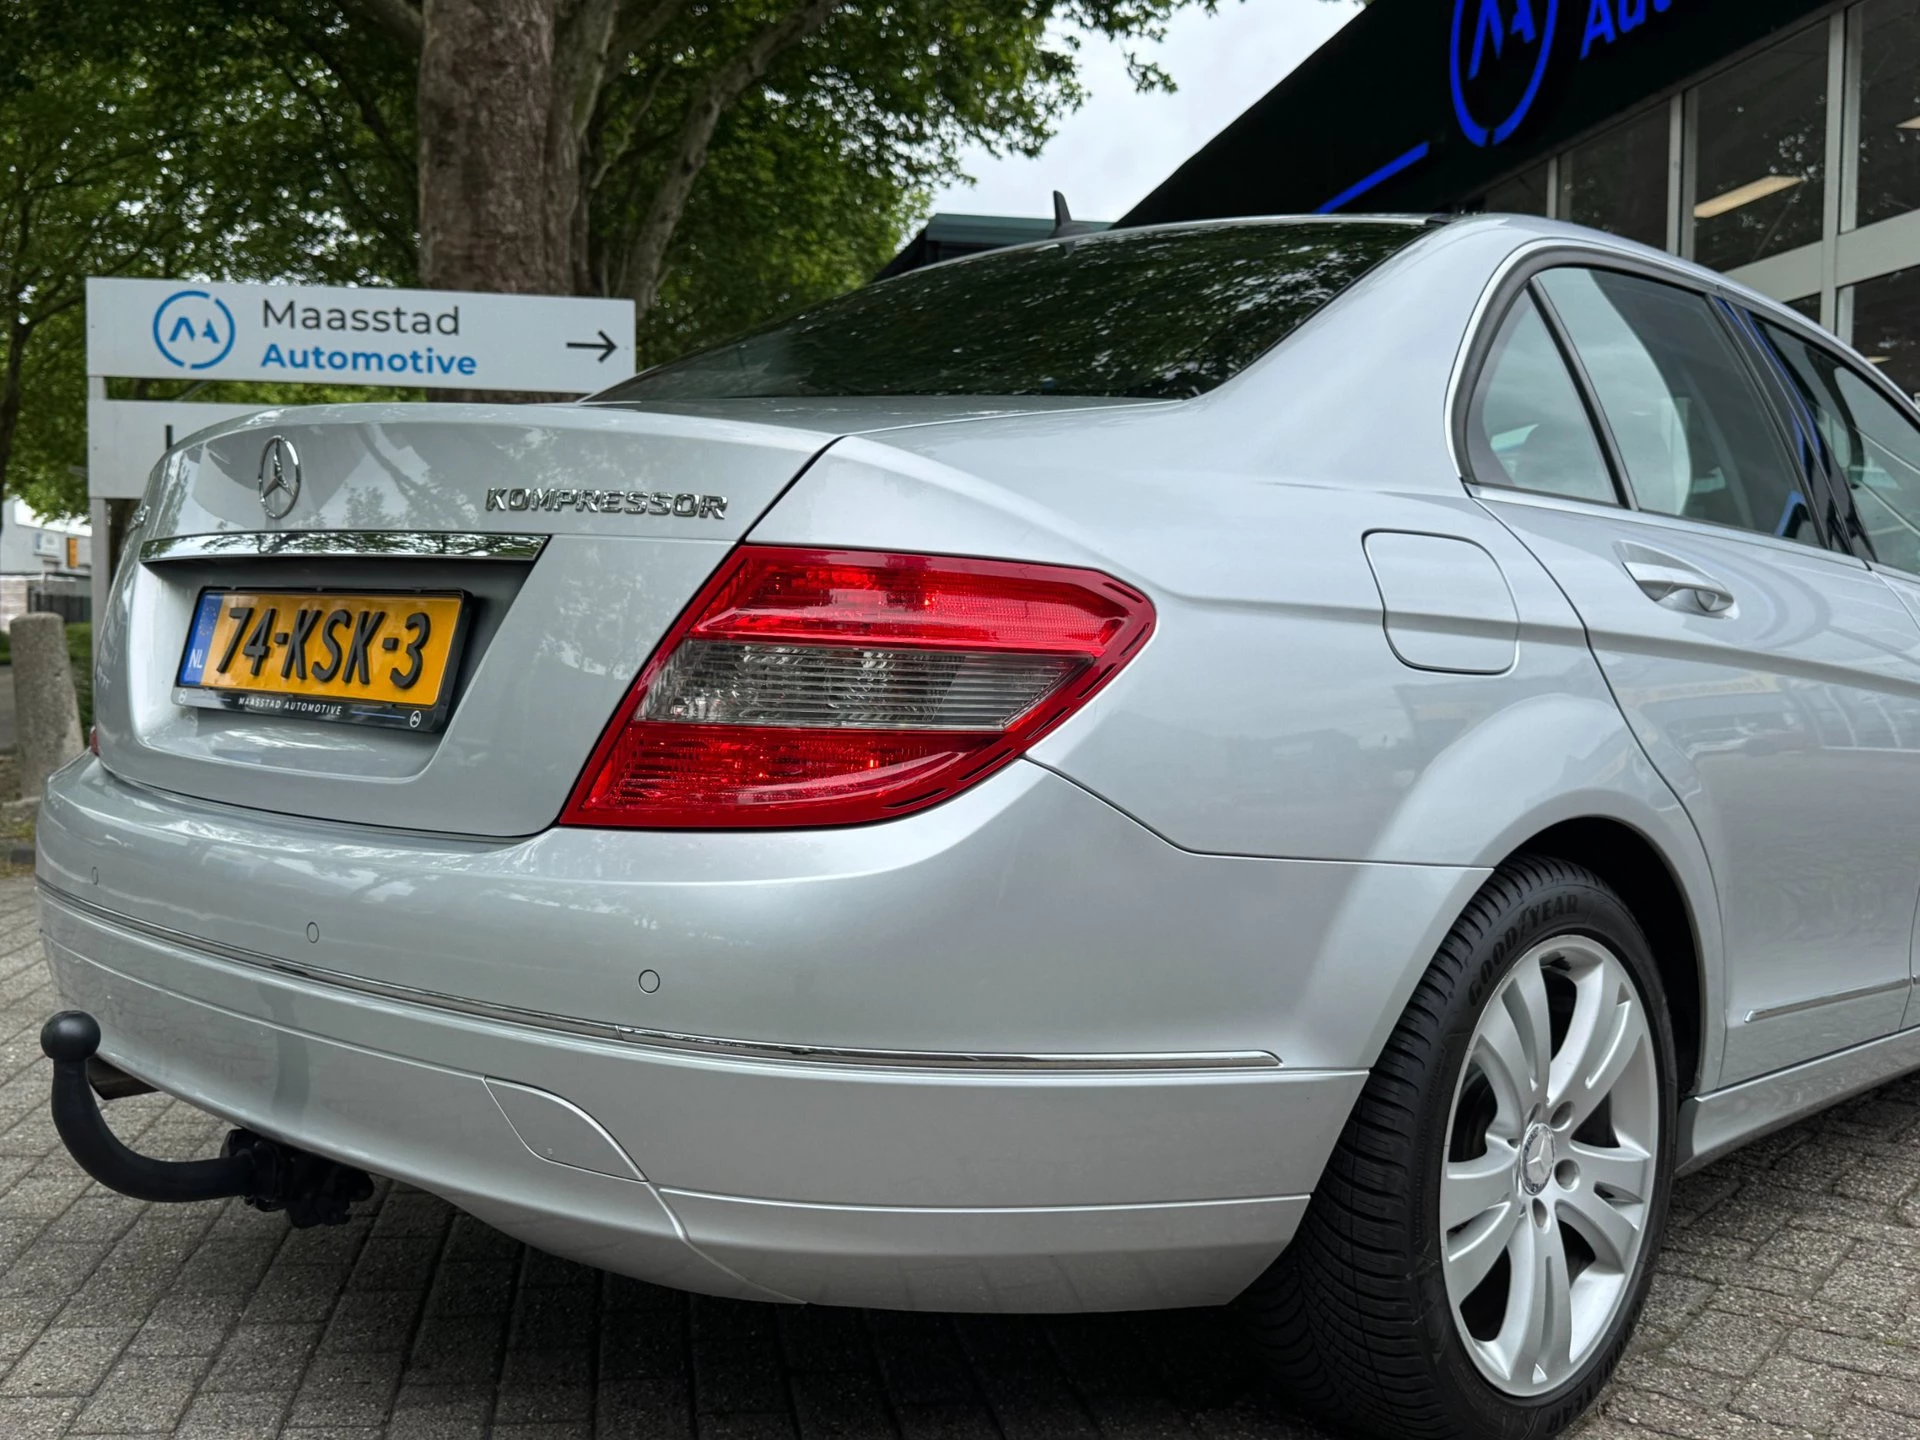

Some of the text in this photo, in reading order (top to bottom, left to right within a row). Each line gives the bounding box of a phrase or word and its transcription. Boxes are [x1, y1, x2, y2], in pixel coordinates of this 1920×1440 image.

[262, 299, 460, 336] Maasstad
[260, 343, 477, 376] Automotive
[485, 486, 728, 520] KOMPRESSOR
[188, 648, 203, 669] NL
[216, 606, 431, 690] 74-KSK-3
[238, 697, 343, 715] MAASSTAD AUTOMOTIVE
